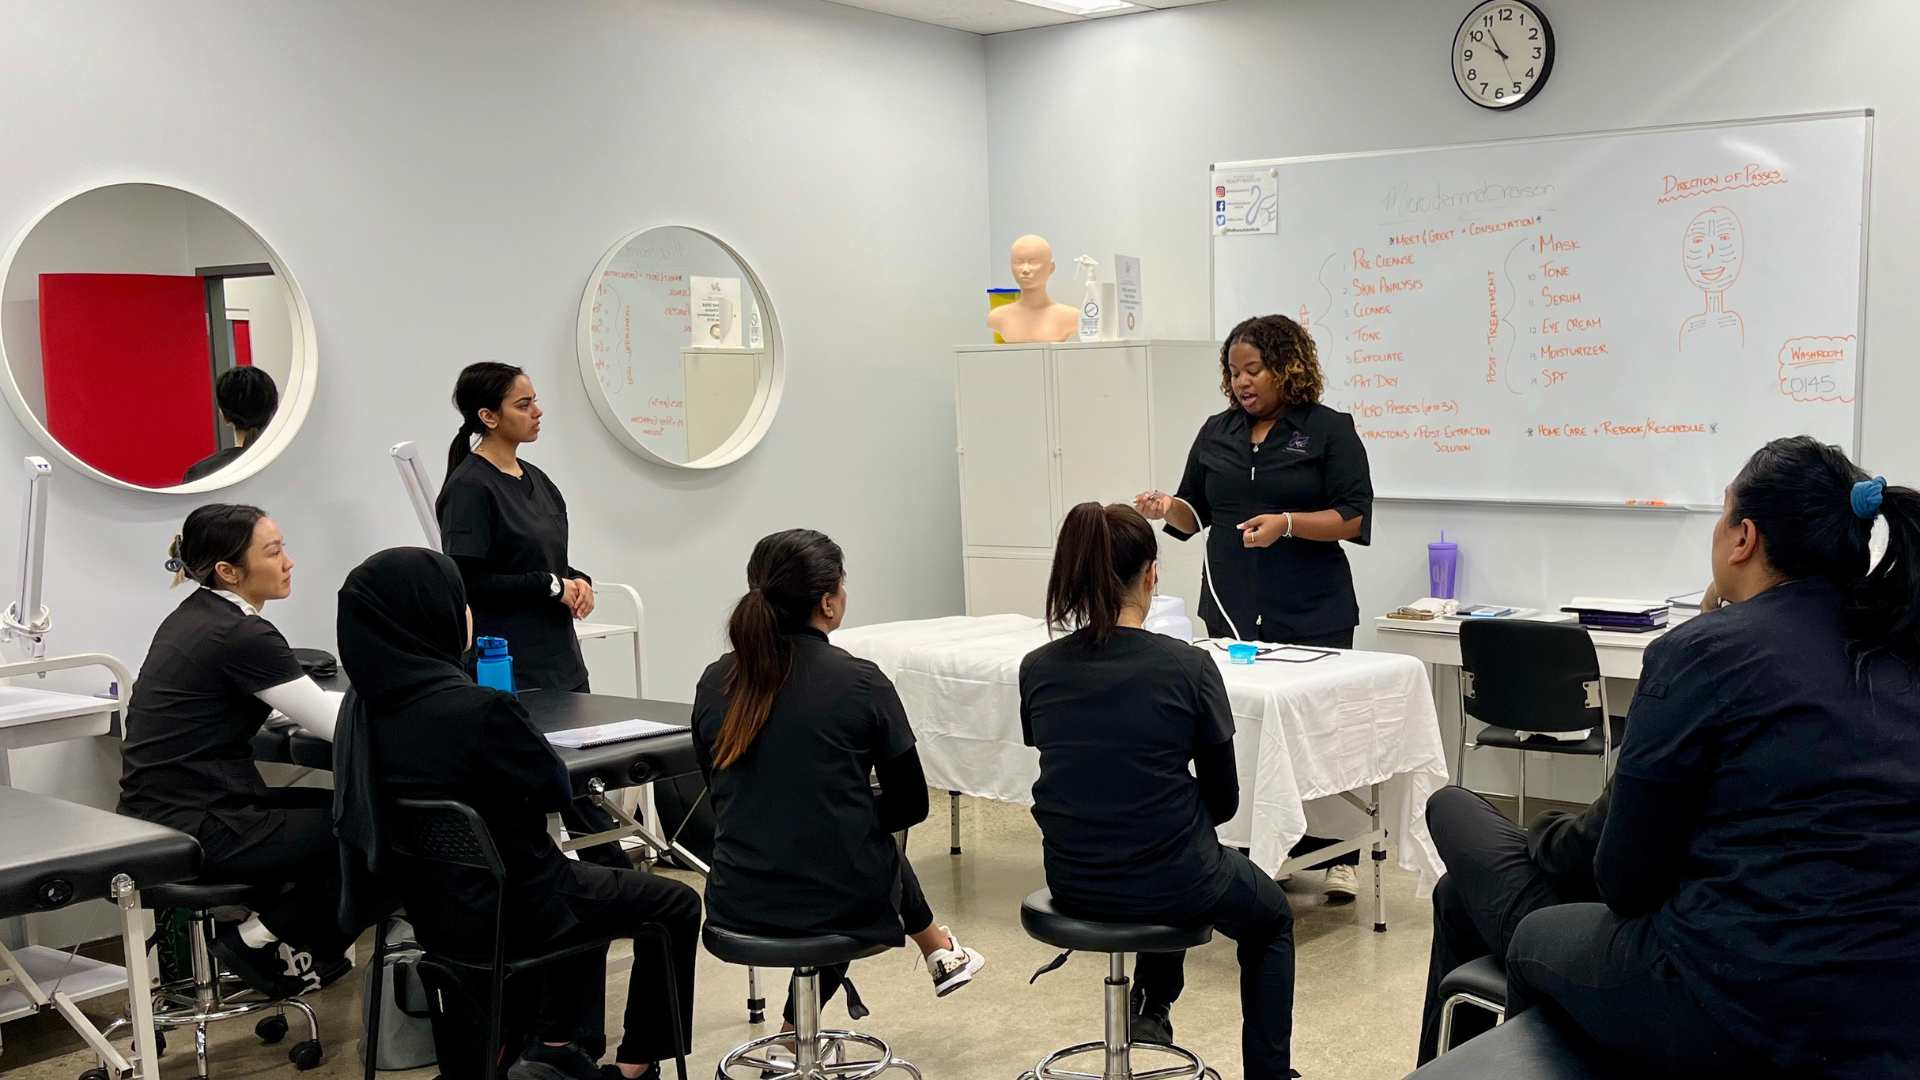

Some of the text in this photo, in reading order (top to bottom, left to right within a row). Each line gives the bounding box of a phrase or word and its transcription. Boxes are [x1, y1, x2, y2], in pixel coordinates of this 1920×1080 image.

[1498, 8, 1513, 21] 12
[1519, 14, 1525, 26] 1
[1483, 15, 1494, 27] 11
[1469, 30, 1484, 42] 10
[1528, 28, 1538, 40] 2
[1464, 49, 1473, 61] 9
[1532, 47, 1542, 59] 3
[1467, 69, 1477, 80] 8
[1525, 67, 1534, 79] 4
[1480, 82, 1488, 95] 7
[1495, 88, 1504, 99] 6
[1512, 82, 1522, 94] 5
